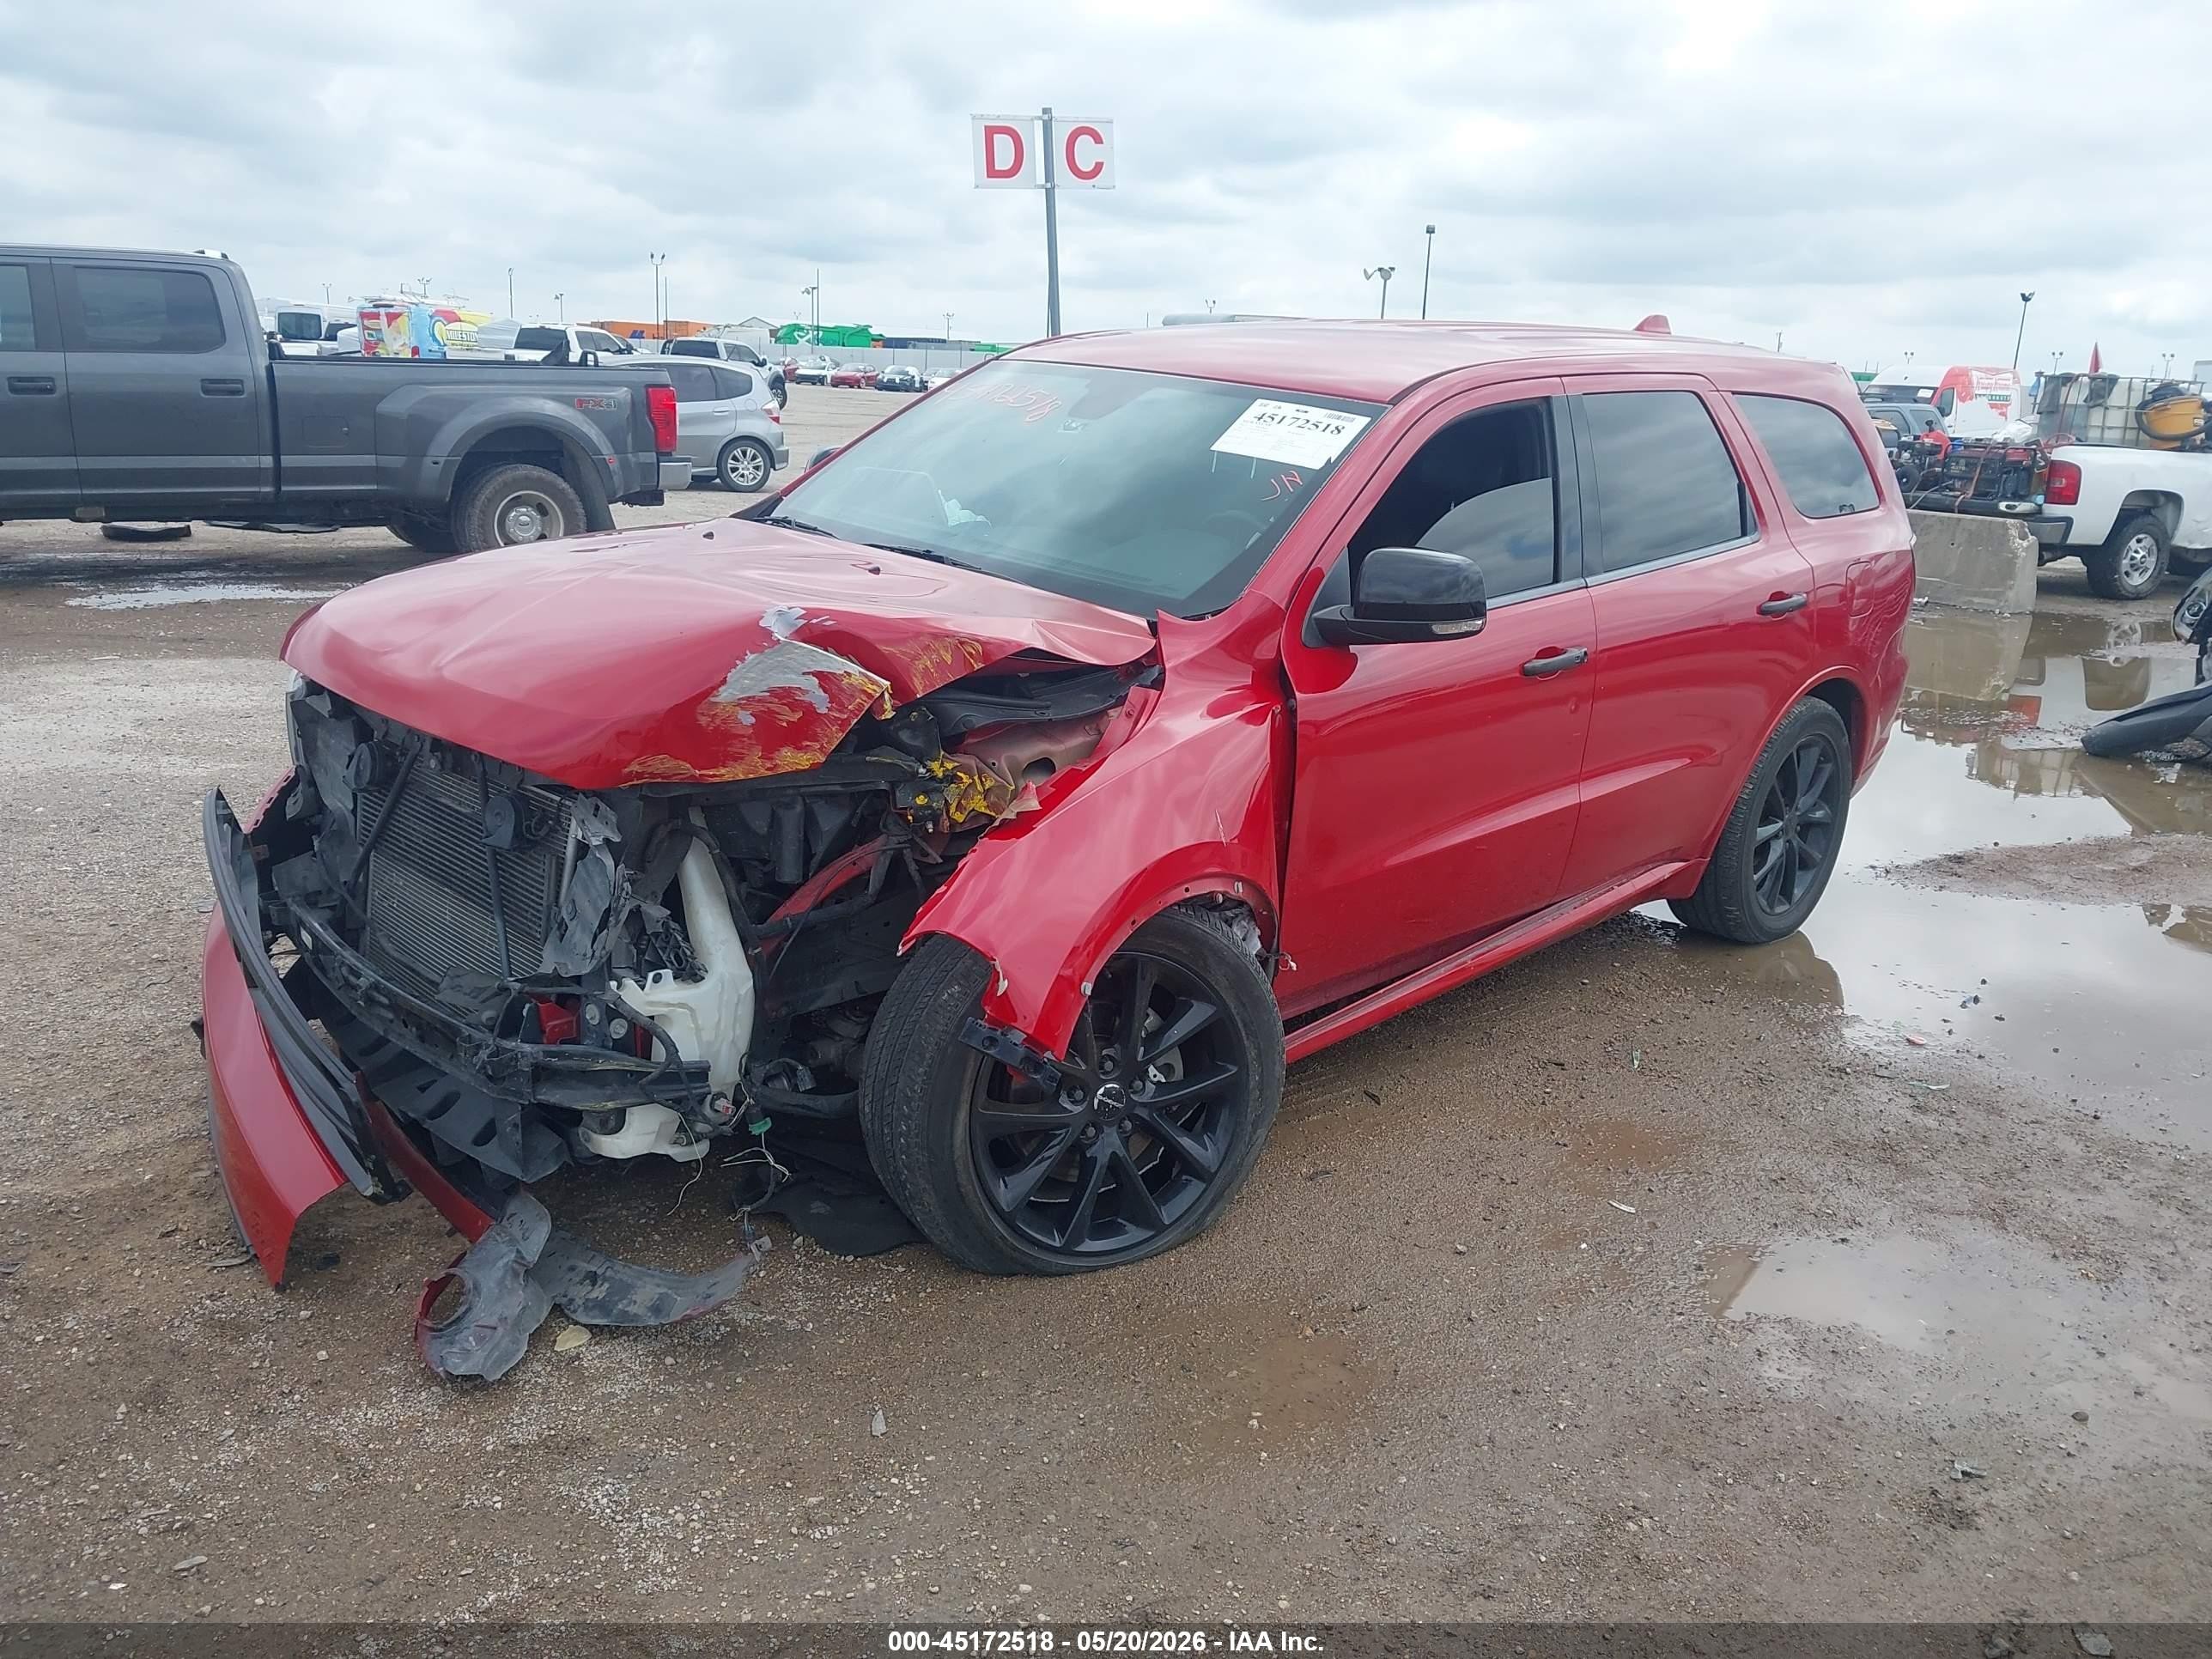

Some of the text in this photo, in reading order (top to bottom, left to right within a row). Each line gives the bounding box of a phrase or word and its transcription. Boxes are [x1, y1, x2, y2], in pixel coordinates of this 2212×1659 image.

[983, 124, 1024, 179] D
[1065, 124, 1105, 181] C
[574, 398, 617, 410] FX4
[1254, 412, 1346, 435] 45172518
